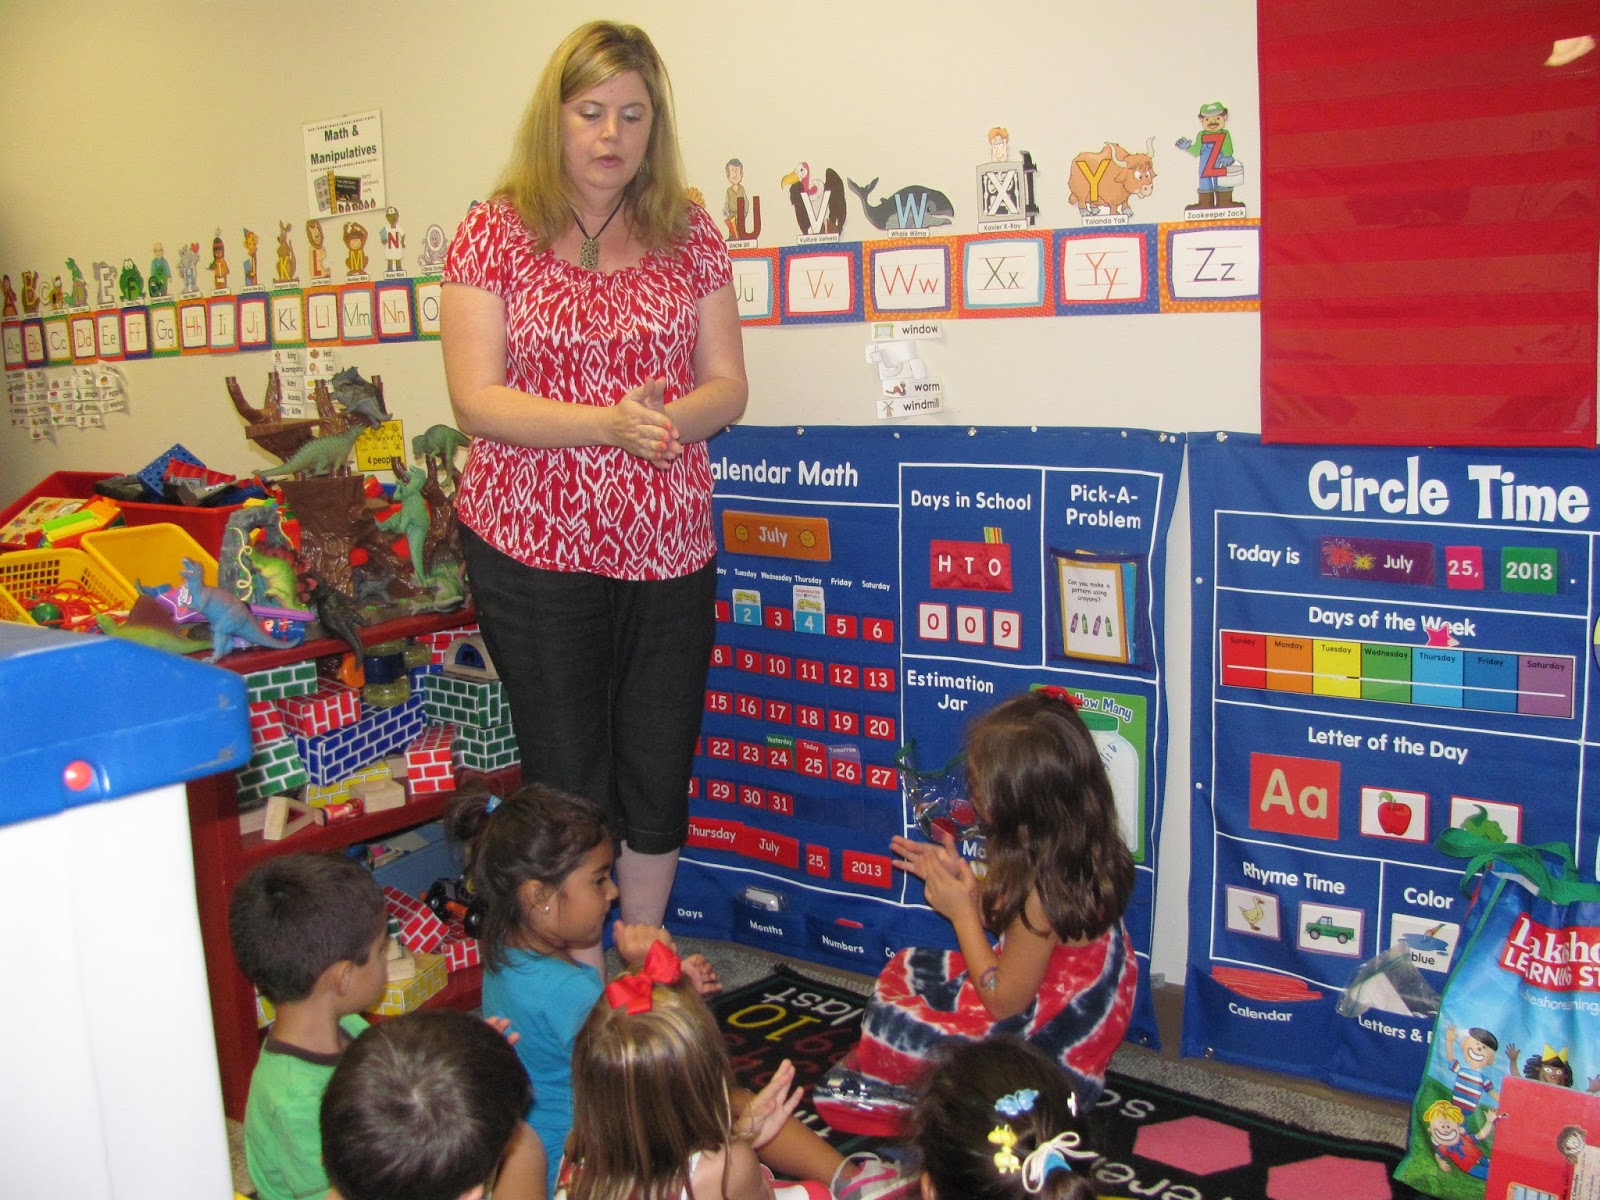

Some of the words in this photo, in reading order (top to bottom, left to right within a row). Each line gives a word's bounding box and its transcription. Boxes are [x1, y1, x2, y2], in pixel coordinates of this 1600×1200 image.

[324, 127, 349, 142] Math
[351, 124, 359, 137] &
[310, 144, 377, 165] Manipulatives
[1201, 133, 1227, 178] Z
[1076, 159, 1112, 202] Y
[984, 170, 1019, 216] X
[737, 196, 761, 240] U
[800, 190, 831, 235] V
[894, 193, 928, 229] W
[1084, 217, 1111, 226] Yolanda
[1112, 216, 1127, 224] Yak
[1187, 211, 1225, 220] Zookeeper
[1226, 209, 1245, 218] Zack
[891, 230, 909, 238] Whale
[983, 223, 1003, 231] Xavier
[1003, 223, 1022, 231] X-Ray
[387, 232, 400, 249] N
[279, 256, 291, 280] K
[313, 250, 322, 276] L
[350, 250, 364, 270] M
[1193, 247, 1235, 282] Zz
[806, 270, 834, 298] Vv
[880, 265, 938, 295] Ww
[984, 257, 1020, 290] Xx
[1085, 252, 1120, 300] Yy
[100, 267, 114, 304] E
[278, 309, 297, 331] Kk
[344, 303, 370, 326] Mm
[383, 300, 405, 324] Nn
[76, 328, 92, 348] Dd
[102, 325, 116, 346] Ee
[156, 320, 174, 347] Gg
[185, 316, 203, 337] Hh
[246, 312, 259, 341] Jj
[902, 324, 938, 335] window
[50, 331, 67, 350] Cc
[287, 352, 297, 360] king
[914, 383, 940, 392] worm
[903, 398, 940, 411] windmill
[368, 456, 372, 464] 4
[711, 457, 792, 485] alendar
[798, 460, 858, 488] Math
[911, 490, 950, 511] Days
[956, 491, 971, 508] in
[975, 491, 1031, 510] School
[1070, 484, 1138, 504] Pick-A-
[1308, 455, 1450, 516] Circle
[1468, 464, 1590, 524] Time
[1066, 508, 1141, 529] Problem
[759, 526, 788, 547] July
[938, 554, 951, 573] H
[964, 556, 974, 574] T
[1227, 543, 1281, 567] Today
[1286, 546, 1300, 565] is
[1383, 555, 1413, 574] July
[1447, 559, 1479, 579] 25,
[1505, 561, 1553, 581] 2013
[734, 569, 758, 579] Tuesday
[761, 571, 793, 583] Wednesday
[795, 574, 823, 585] Thursday
[831, 577, 853, 587] Friday
[861, 580, 891, 591] Saturday
[1093, 589, 1107, 597] using
[743, 608, 752, 622] 2
[774, 611, 783, 627] 3
[804, 615, 814, 631] 4
[836, 618, 847, 635] 5
[872, 622, 883, 639] 6
[1001, 620, 1012, 638] 9
[1308, 606, 1353, 631] Days
[1357, 611, 1379, 630] of
[1384, 613, 1416, 632] the
[1230, 636, 1256, 647] Sunday
[1274, 641, 1303, 651] Monday
[1321, 645, 1352, 655] Tuesday
[1364, 648, 1408, 659] Wednesday
[1419, 652, 1456, 663] Thursday
[1478, 656, 1504, 667] Friday
[1527, 660, 1565, 671] Saturday
[714, 649, 723, 664] 8
[744, 653, 753, 669] 9
[769, 658, 786, 675] 10
[801, 664, 817, 680] 11
[834, 668, 852, 685] 12
[869, 672, 888, 688] 13
[907, 669, 994, 694] Estimation
[938, 694, 968, 712] Jar
[1102, 696, 1133, 723] Many
[710, 694, 727, 710] 15
[740, 698, 757, 715] 16
[770, 703, 786, 720] 17
[801, 708, 818, 726] 18
[834, 713, 852, 731] 19
[869, 719, 889, 736] 20
[766, 736, 793, 747] Yesterday
[802, 742, 819, 752] Today
[1308, 727, 1361, 749] Letter
[1367, 733, 1389, 752] of
[1394, 737, 1425, 757] the
[1429, 741, 1468, 764] Day
[712, 741, 730, 756] 22
[742, 746, 759, 762] 23
[771, 750, 788, 766] 24
[804, 757, 823, 774] 25
[836, 762, 855, 780] 26
[871, 769, 891, 786] 27
[712, 783, 730, 799] 29
[743, 789, 761, 805] 30
[773, 795, 788, 812] 31
[1260, 769, 1328, 819] Aa
[759, 837, 780, 856] July
[808, 853, 826, 870] 25,
[851, 861, 882, 878] 2013
[1242, 861, 1298, 887] Rhyme
[1304, 872, 1345, 895] Time
[1403, 887, 1453, 909] Color
[677, 908, 703, 919] Days
[749, 919, 783, 936] Months
[822, 934, 864, 954] Numbers
[1411, 951, 1435, 966] blue
[762, 987, 865, 1026] last
[1228, 1002, 1293, 1022] Calendar
[728, 1004, 821, 1042] 10
[1358, 1015, 1406, 1040] Letters
[1410, 1028, 1423, 1042] &
